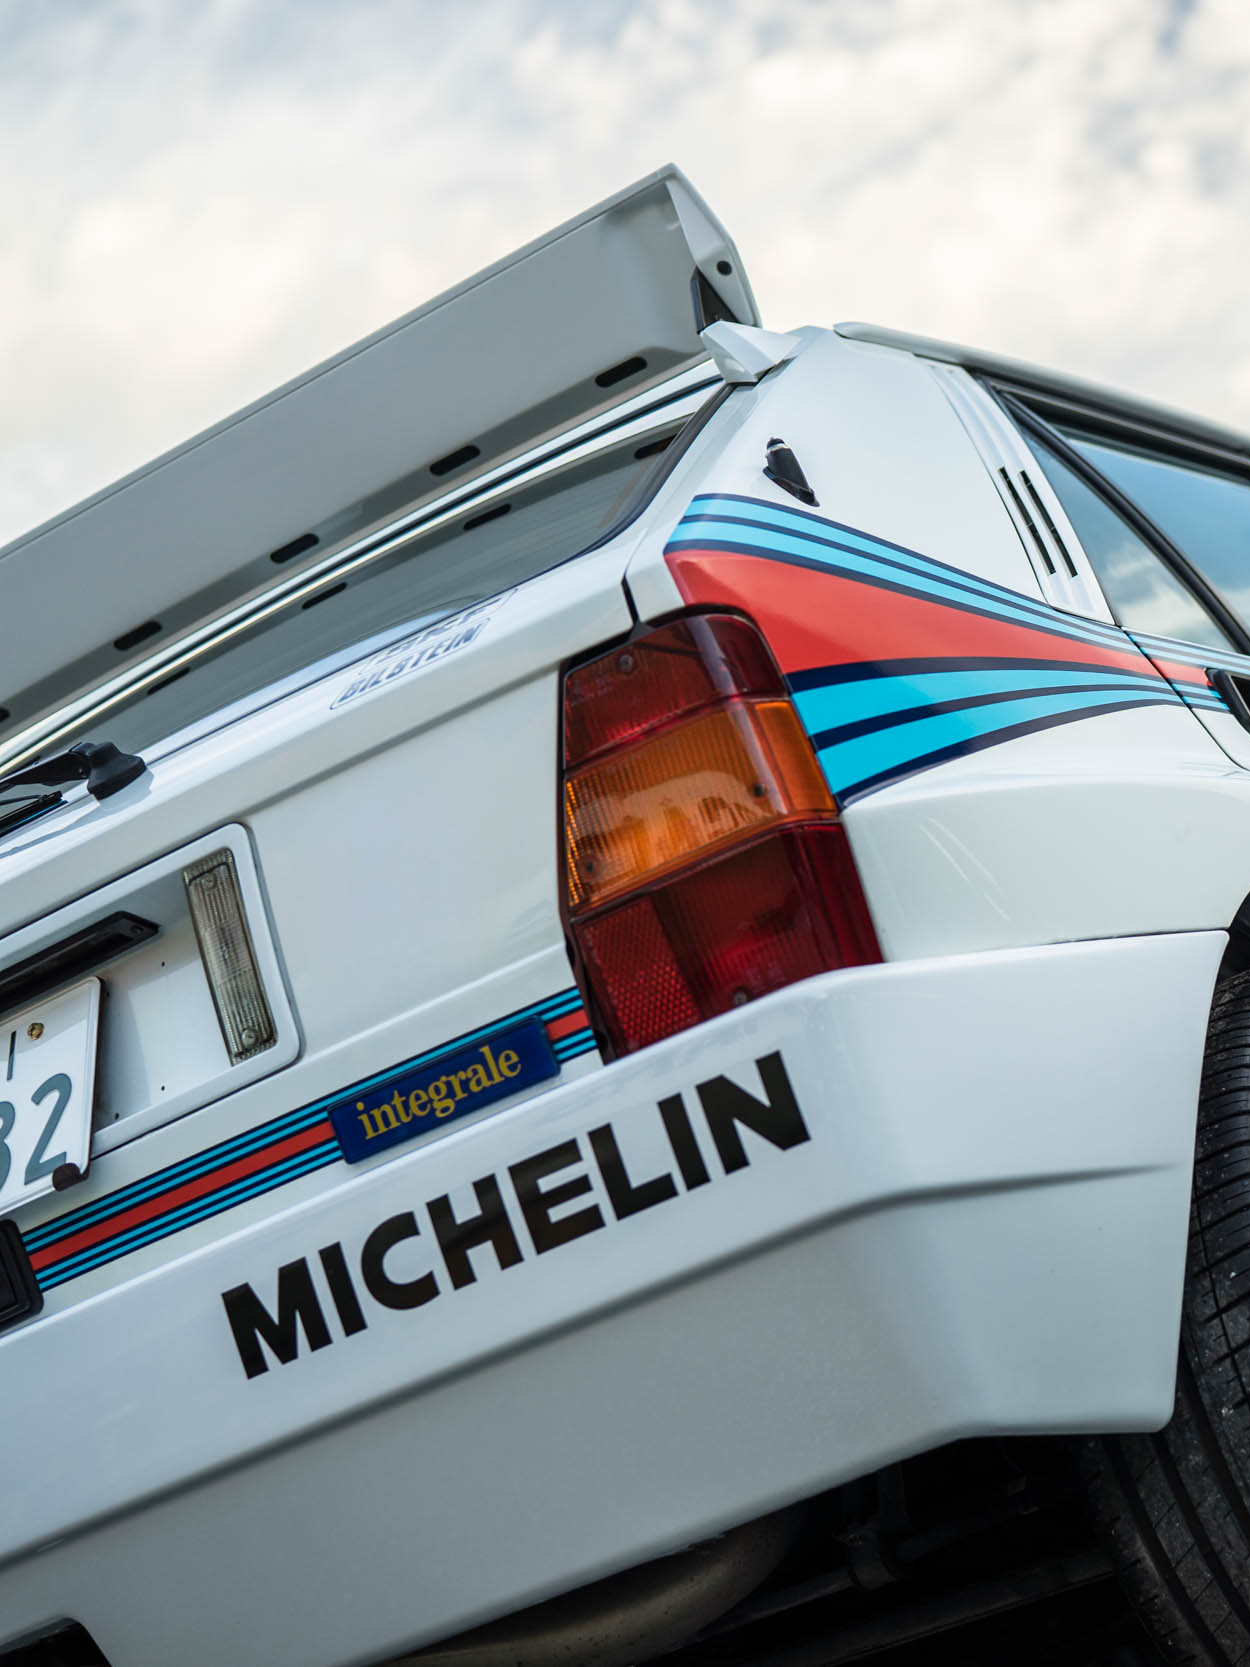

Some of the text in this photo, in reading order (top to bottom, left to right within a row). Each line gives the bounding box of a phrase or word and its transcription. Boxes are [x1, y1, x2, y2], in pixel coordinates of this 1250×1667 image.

[337, 622, 484, 704] BILSTEIN
[355, 1044, 522, 1140] integrale
[221, 1050, 811, 1380] MICHELIN
